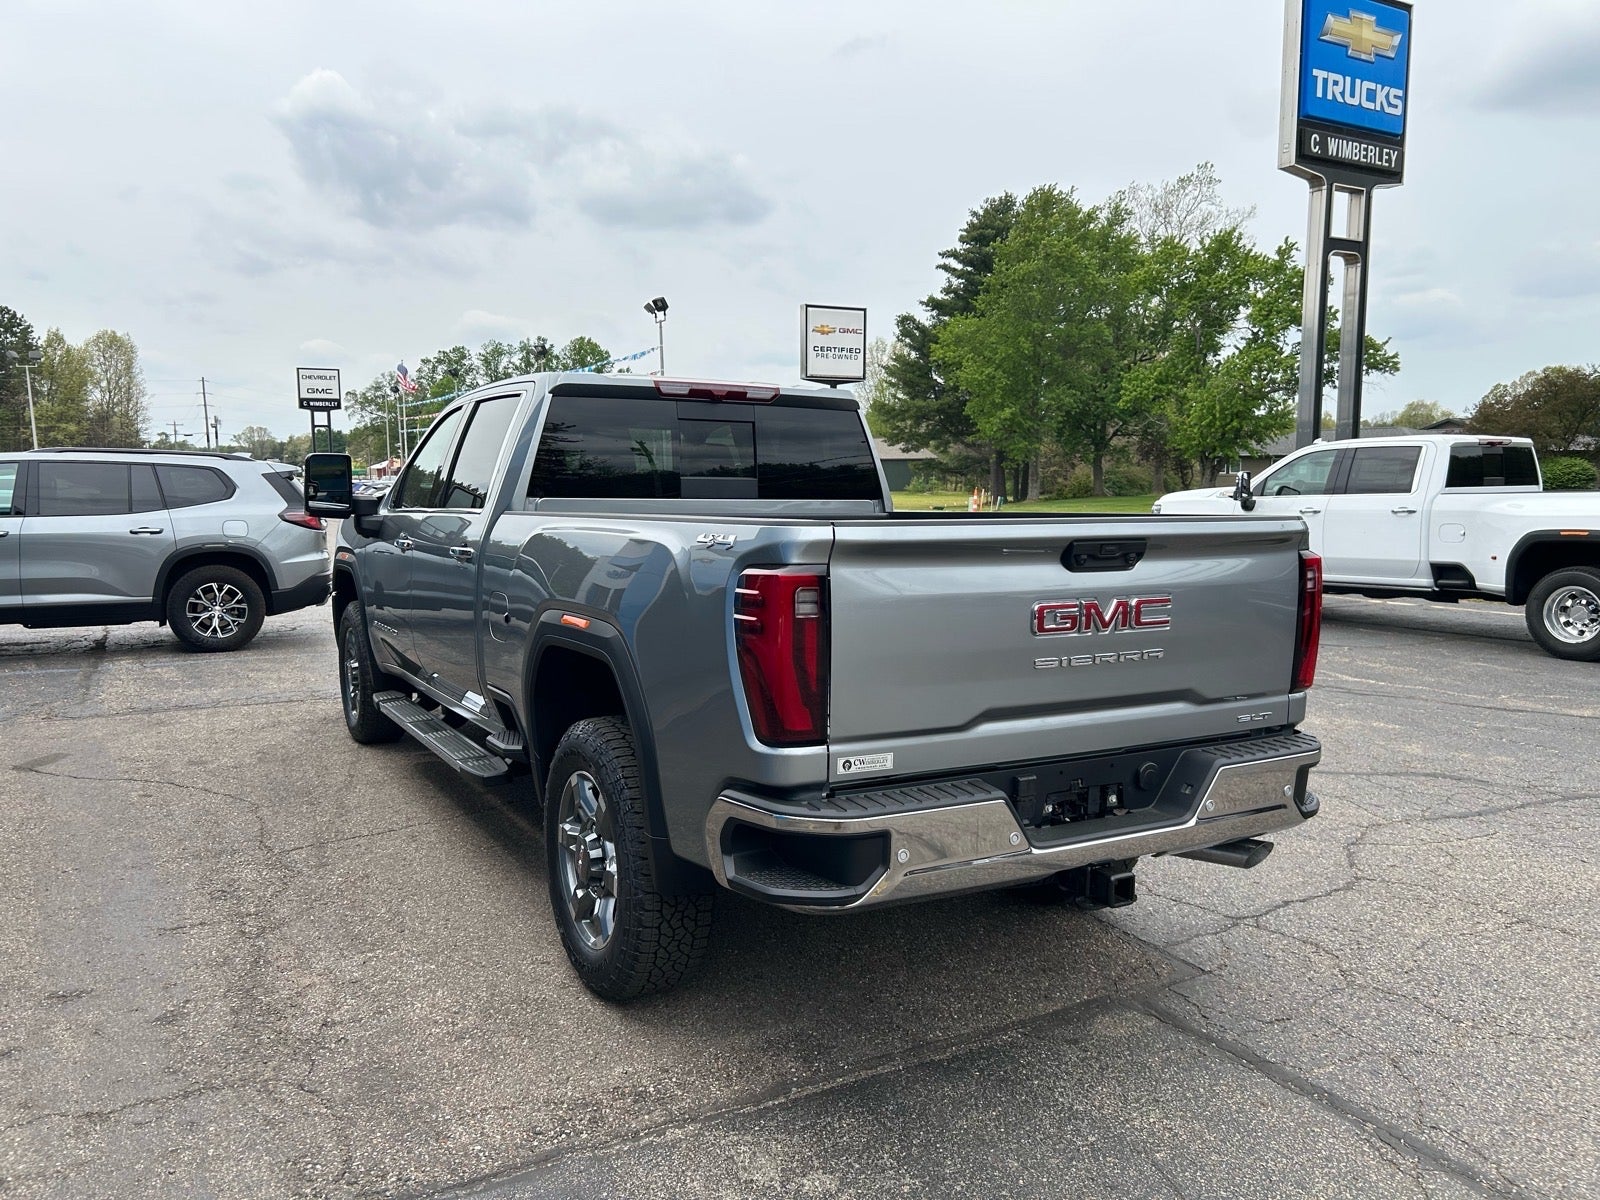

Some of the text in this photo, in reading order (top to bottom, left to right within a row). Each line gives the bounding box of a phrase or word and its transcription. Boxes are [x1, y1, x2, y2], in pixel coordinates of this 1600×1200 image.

[1312, 68, 1403, 116] TRUCKS
[1311, 133, 1398, 168] C. WIMBERLEY
[838, 327, 863, 335] GMC
[813, 345, 861, 354] CERTIFIED
[306, 387, 333, 395] GMC
[1031, 594, 1172, 637] GMC
[1033, 647, 1165, 670] SIERRA
[1236, 711, 1273, 724] SLT
